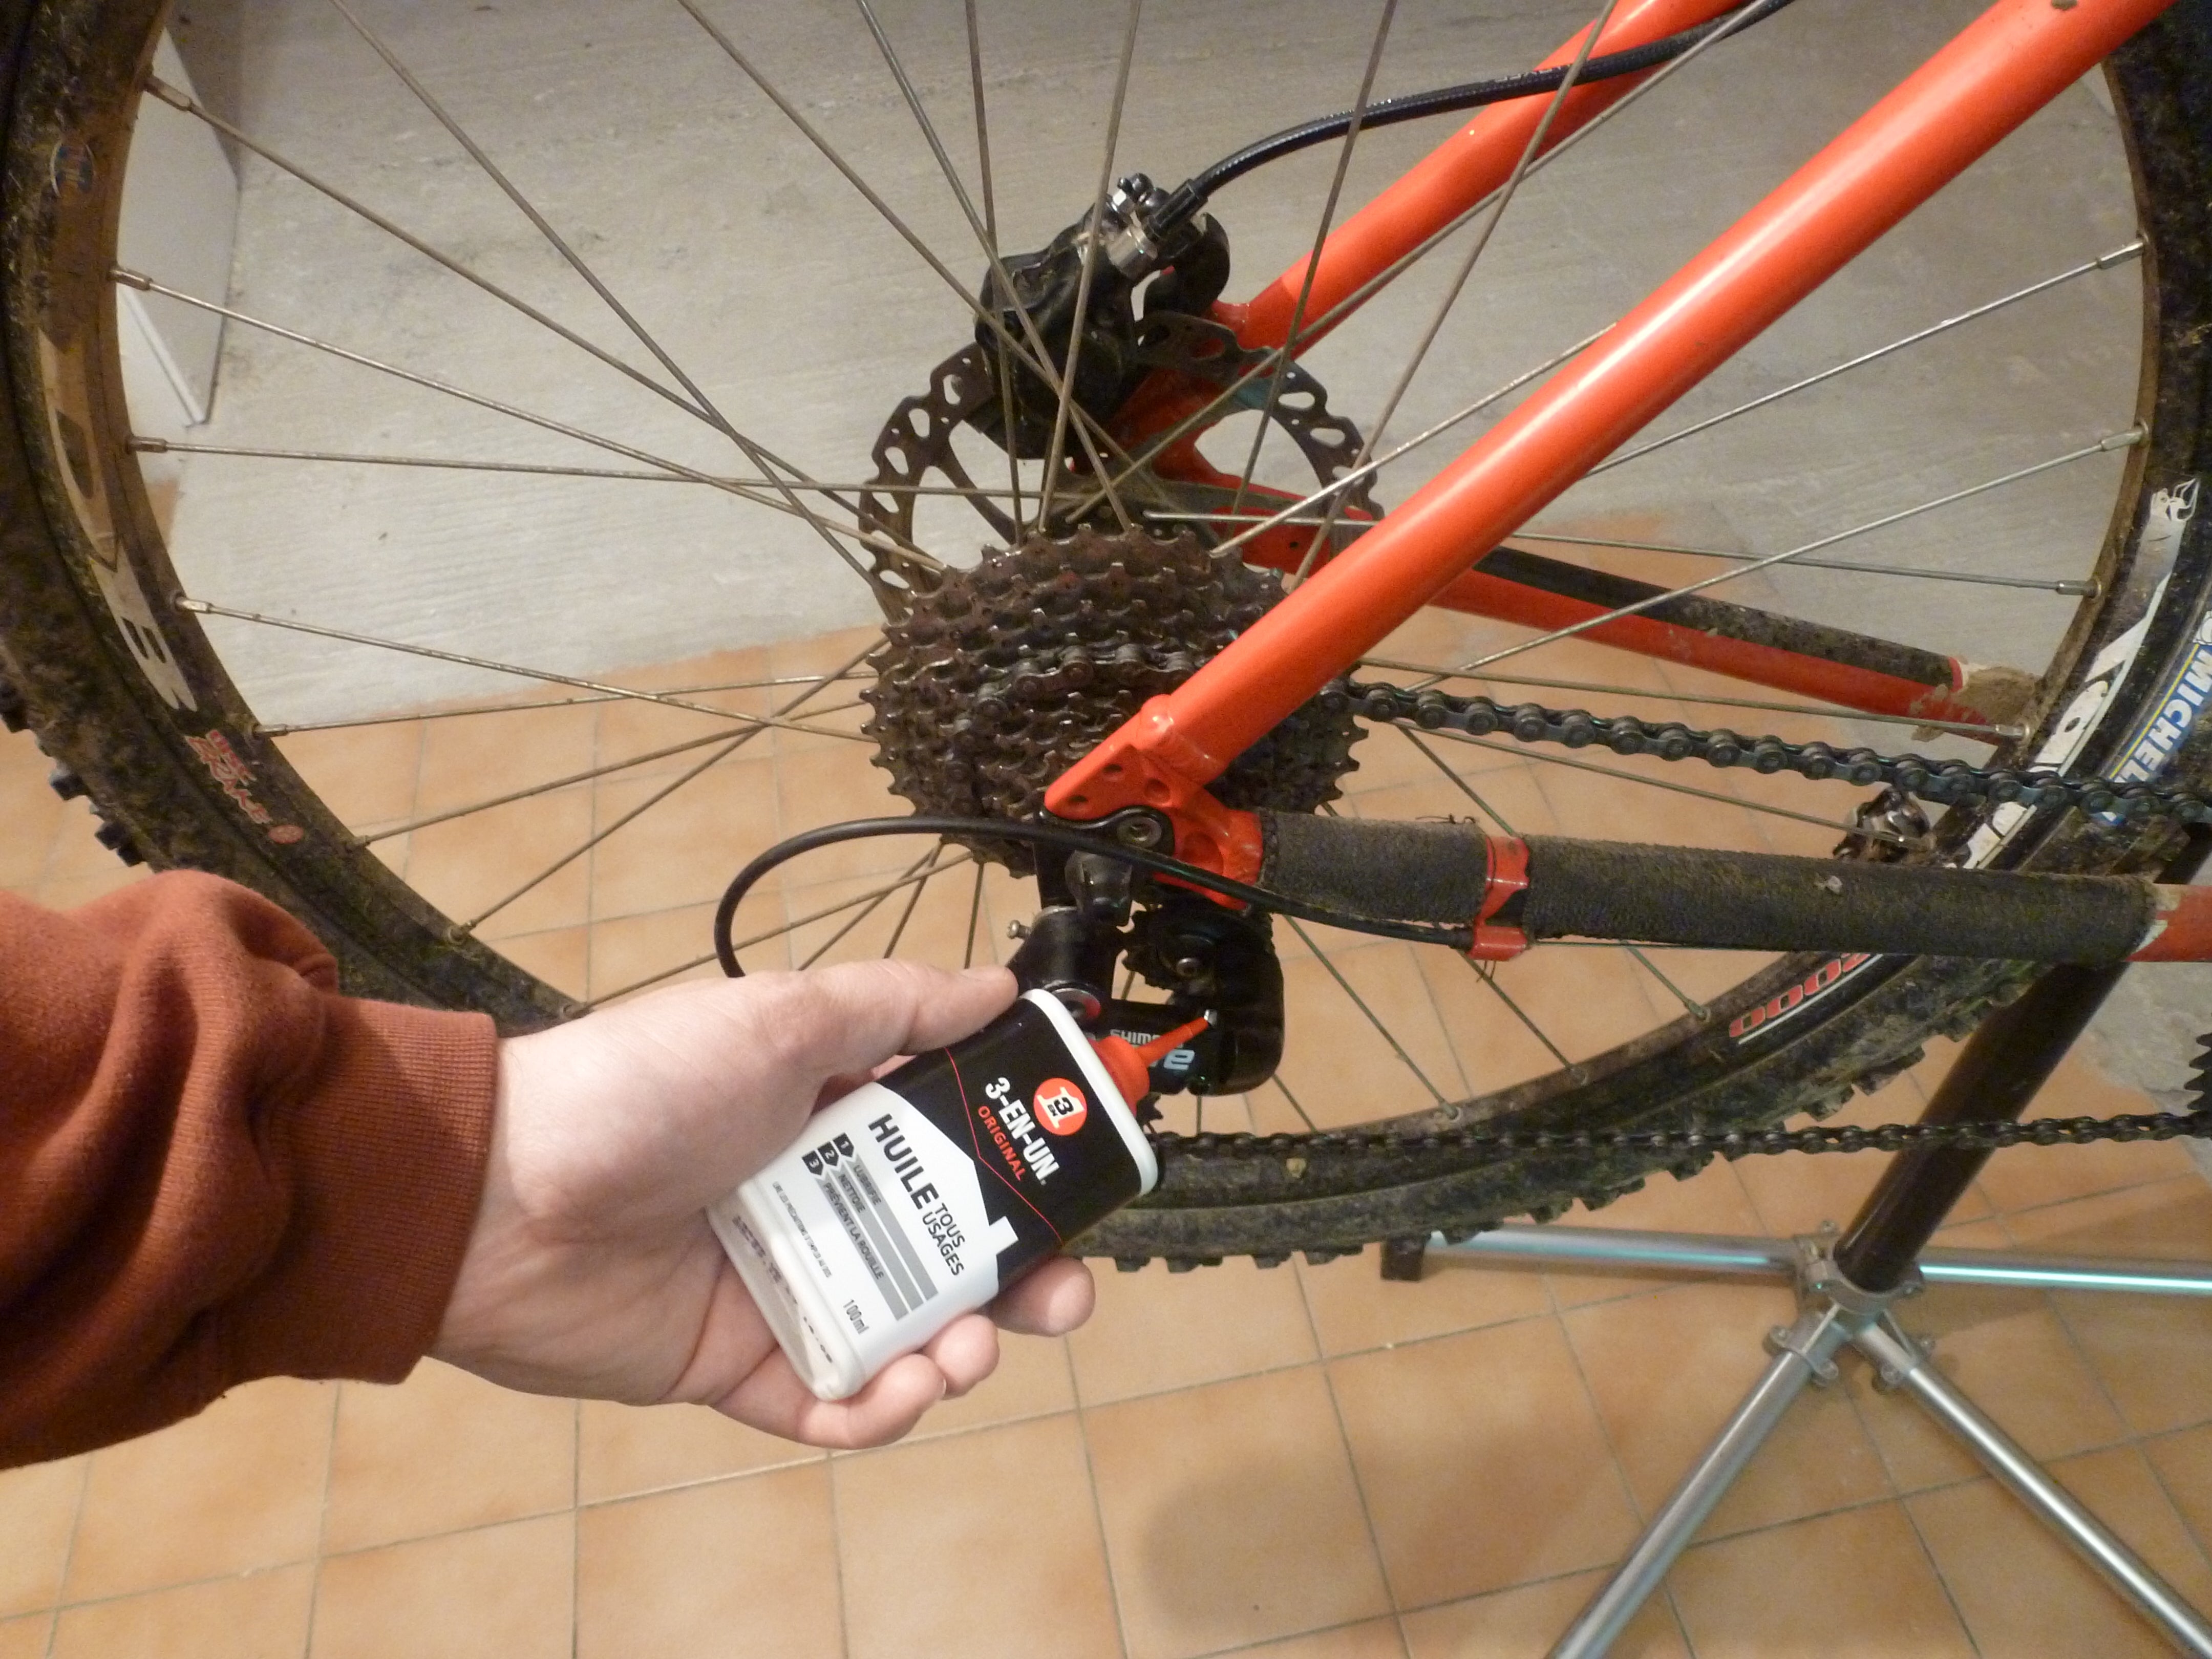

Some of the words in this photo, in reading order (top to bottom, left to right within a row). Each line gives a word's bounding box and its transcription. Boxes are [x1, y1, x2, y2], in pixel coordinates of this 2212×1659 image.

[2102, 648, 2212, 822] MICHEL
[1110, 1029, 1184, 1048] SHIM
[1053, 1097, 1074, 1115] 3
[868, 1113, 940, 1210] HUILE
[978, 1105, 1026, 1181] ORIGINAL
[922, 1211, 964, 1276] USAGES
[935, 1203, 965, 1248] TOUS
[850, 1226, 861, 1241] LA
[857, 1240, 884, 1280] ROUILLE
[843, 1299, 869, 1334] 100ml
